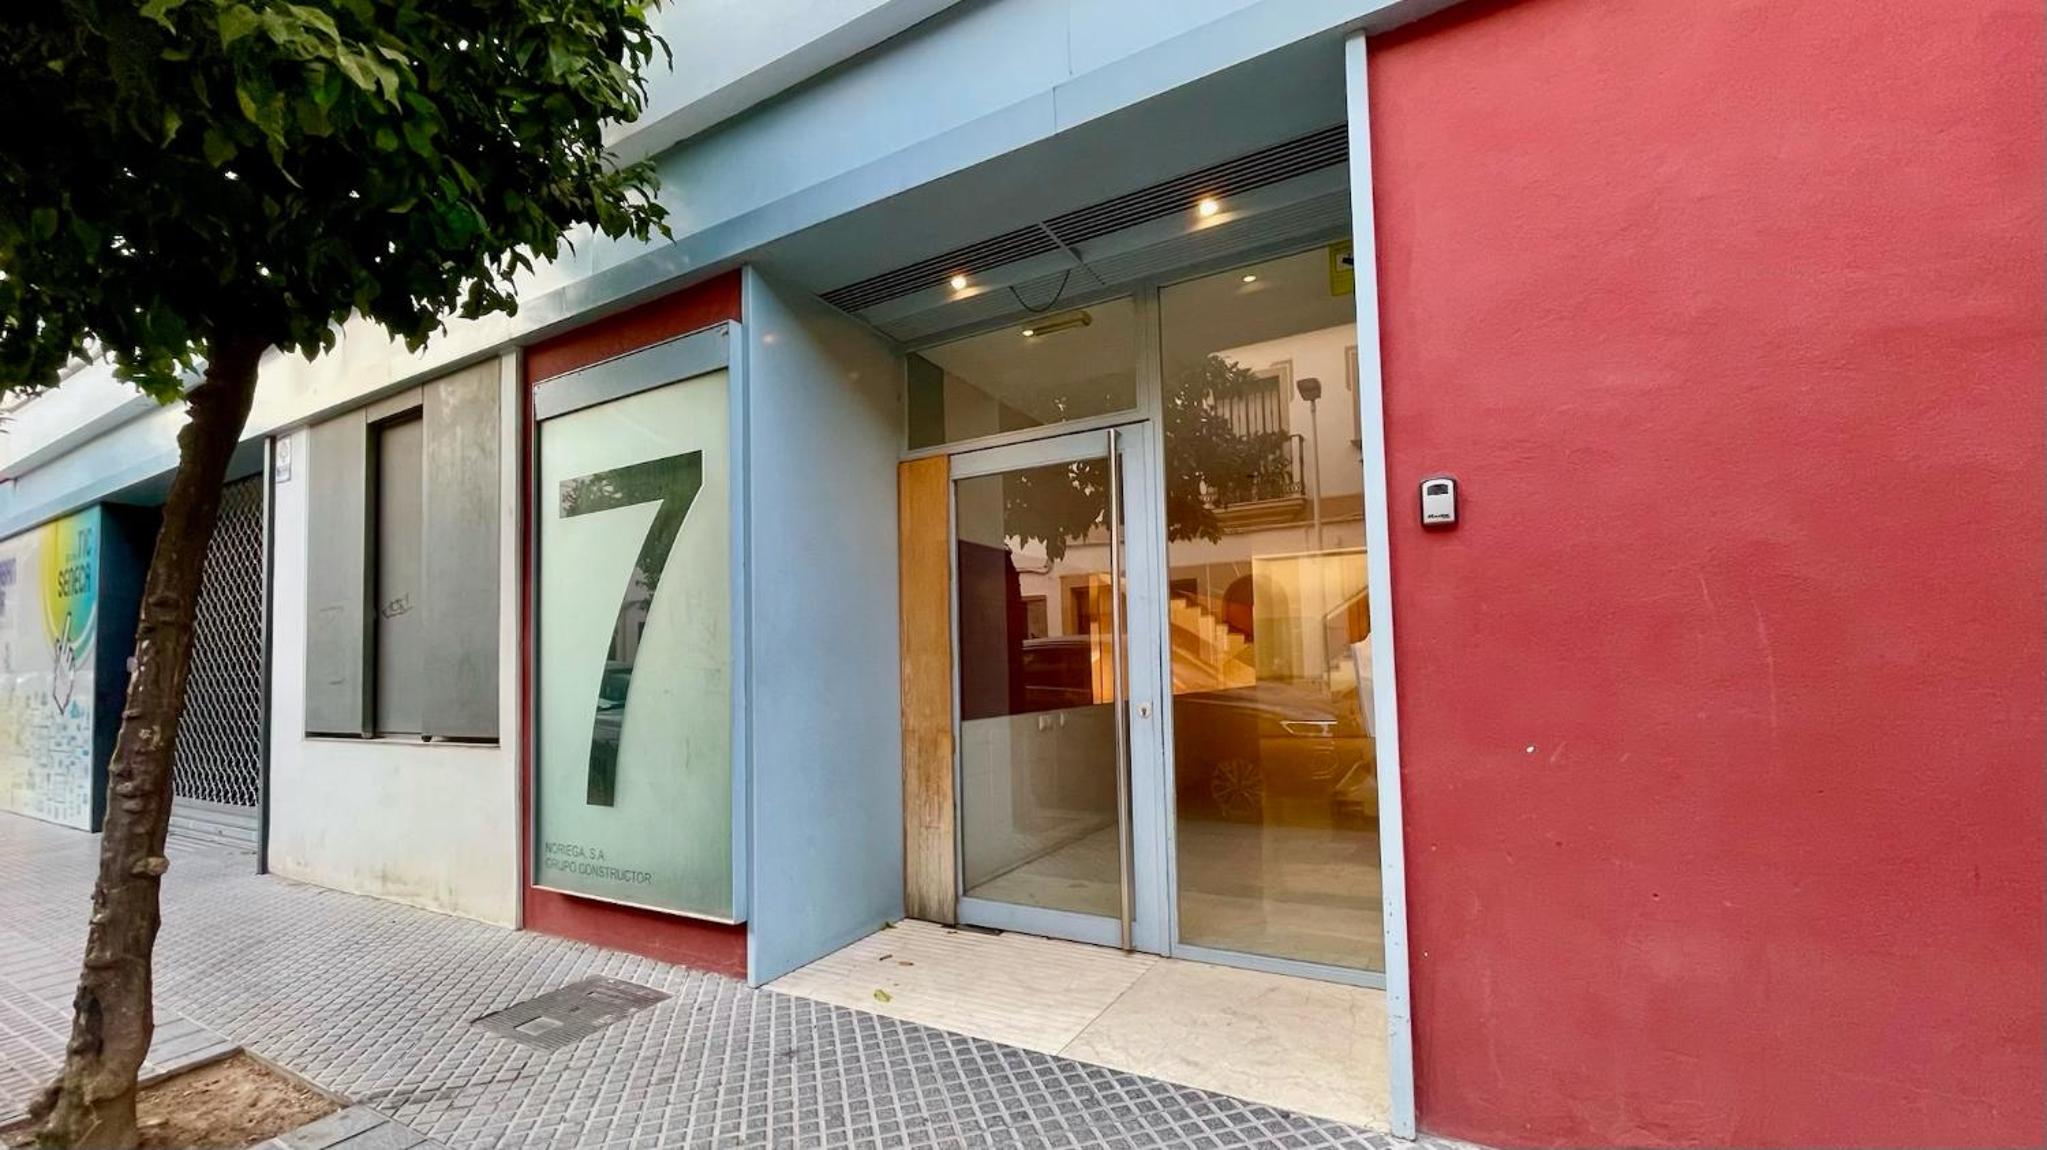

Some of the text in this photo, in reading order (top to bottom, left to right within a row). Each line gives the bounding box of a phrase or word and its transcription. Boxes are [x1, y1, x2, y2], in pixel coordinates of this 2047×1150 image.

[559, 449, 702, 807] 7
[545, 857, 652, 885] GRUPO CONSTRUCTOR
